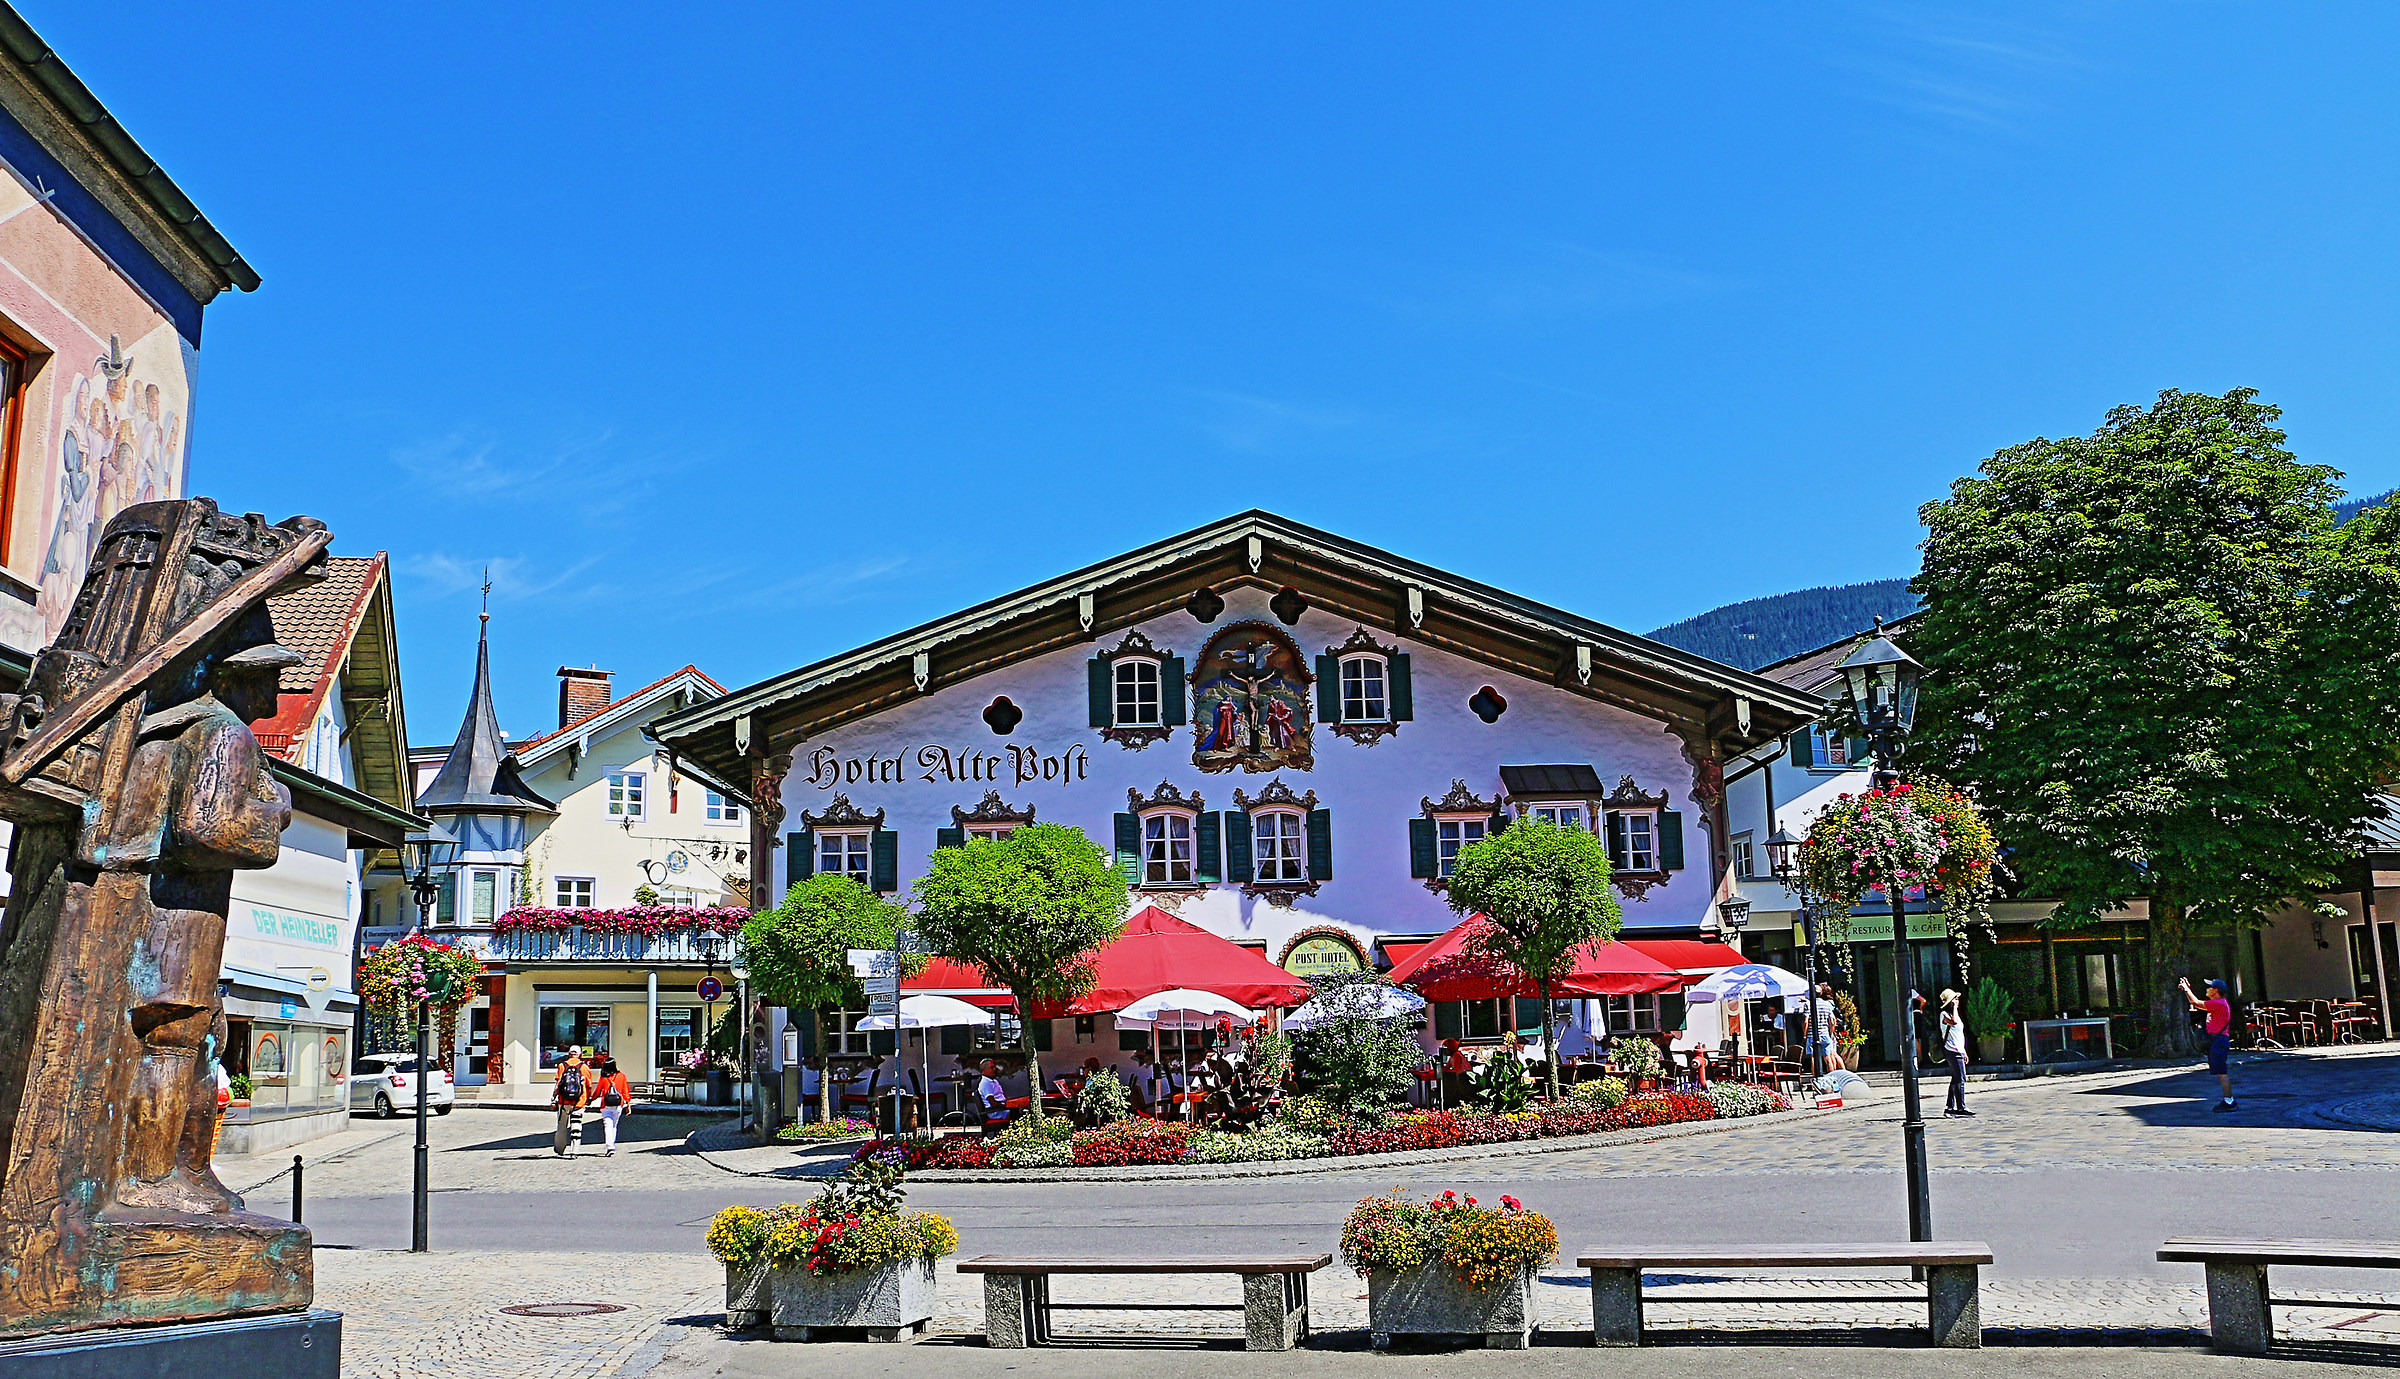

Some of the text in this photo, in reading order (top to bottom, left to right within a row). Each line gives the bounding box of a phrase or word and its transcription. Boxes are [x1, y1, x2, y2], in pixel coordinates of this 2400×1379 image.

[802, 745, 909, 790] Hotel
[916, 744, 1001, 784] Alte
[252, 909, 338, 946] DER HEINZELLER
[1295, 952, 1349, 963] POST HOTEL
[874, 994, 892, 1002] POLIZEI
